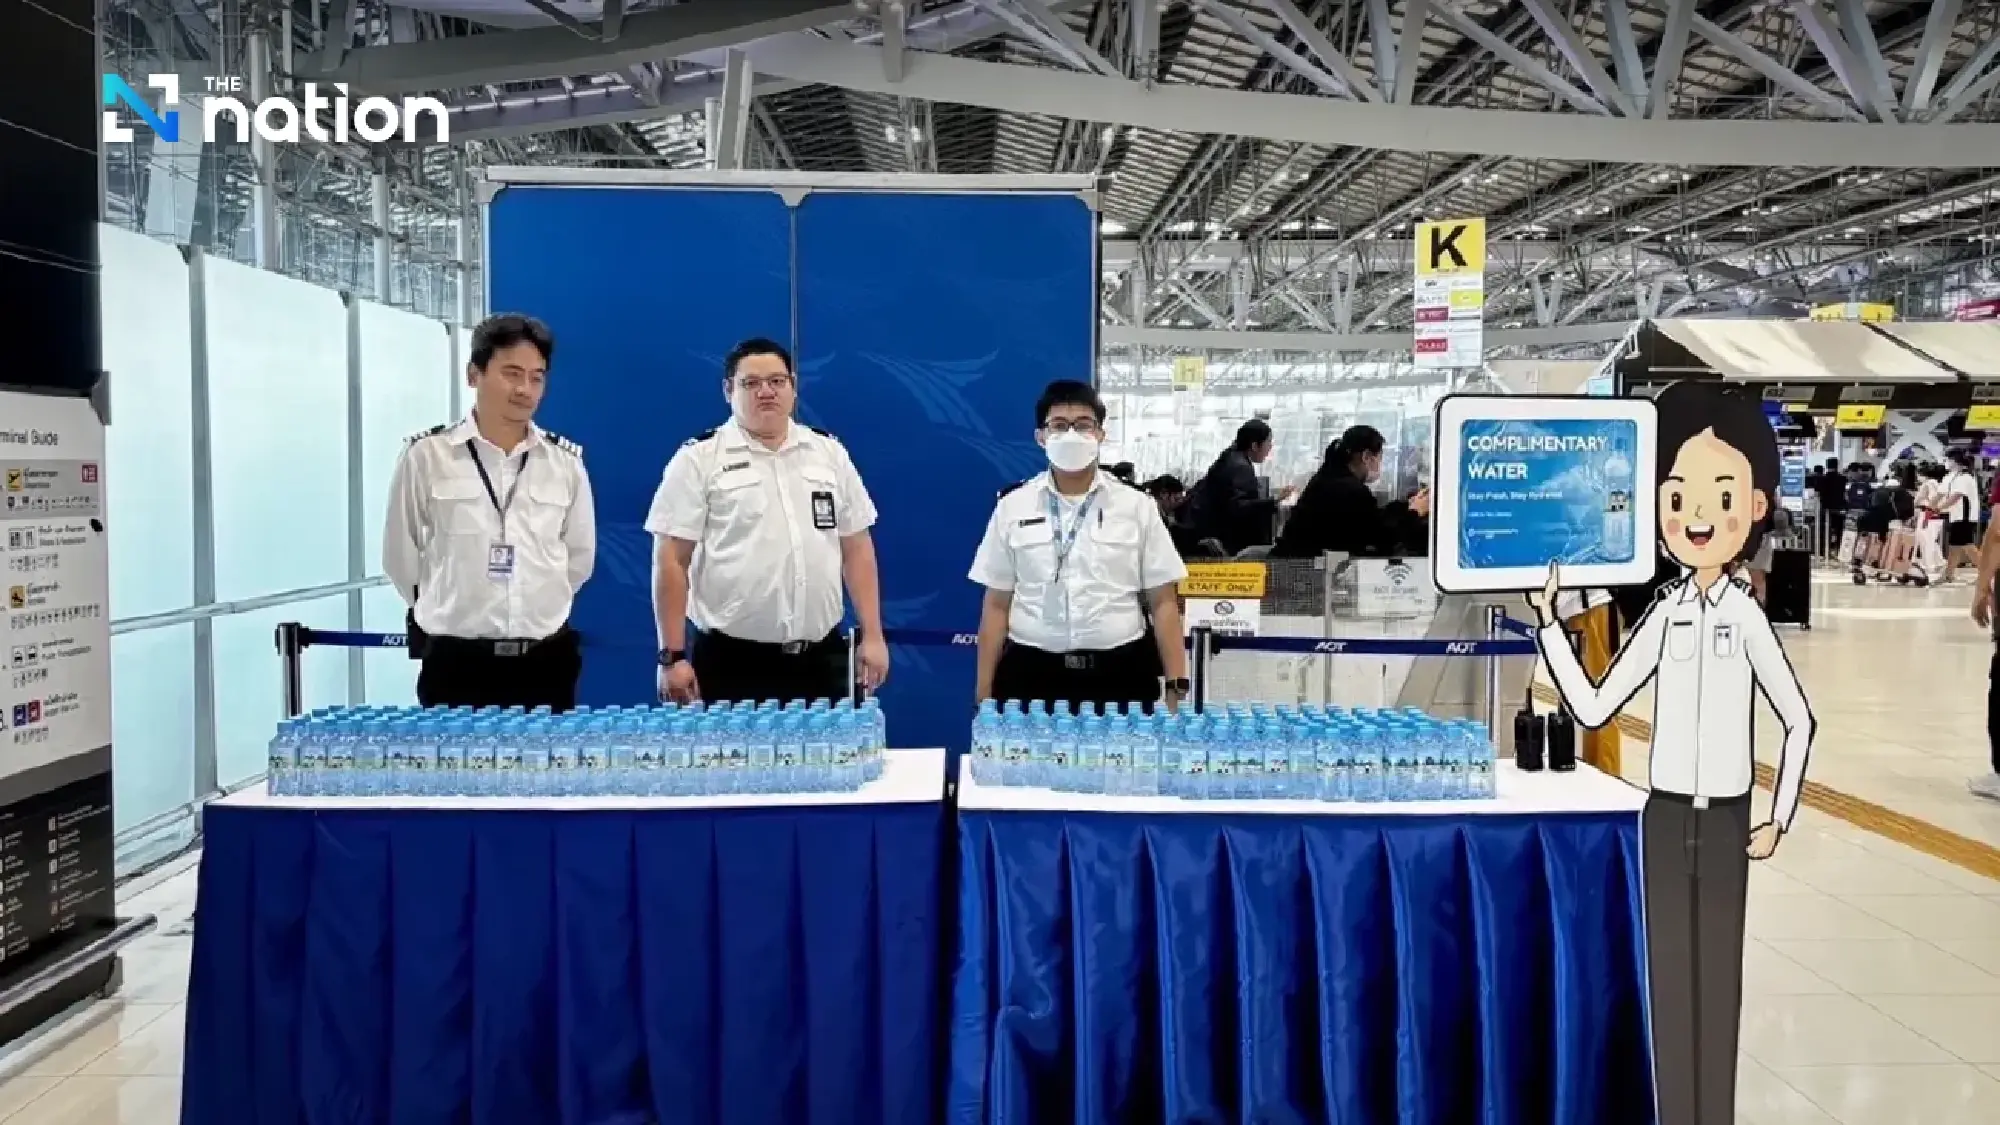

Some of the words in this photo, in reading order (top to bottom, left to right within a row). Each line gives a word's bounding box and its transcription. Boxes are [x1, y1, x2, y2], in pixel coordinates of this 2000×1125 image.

[1431, 225, 1468, 268] K
[31, 428, 58, 446] Guide
[1468, 436, 1608, 452] COMPLIMENTARY
[1468, 462, 1528, 480] WATER
[1188, 582, 1220, 592] STAFF
[1226, 582, 1255, 592] ONLY
[1314, 641, 1348, 653] AOT
[1445, 641, 1478, 654] AOT
